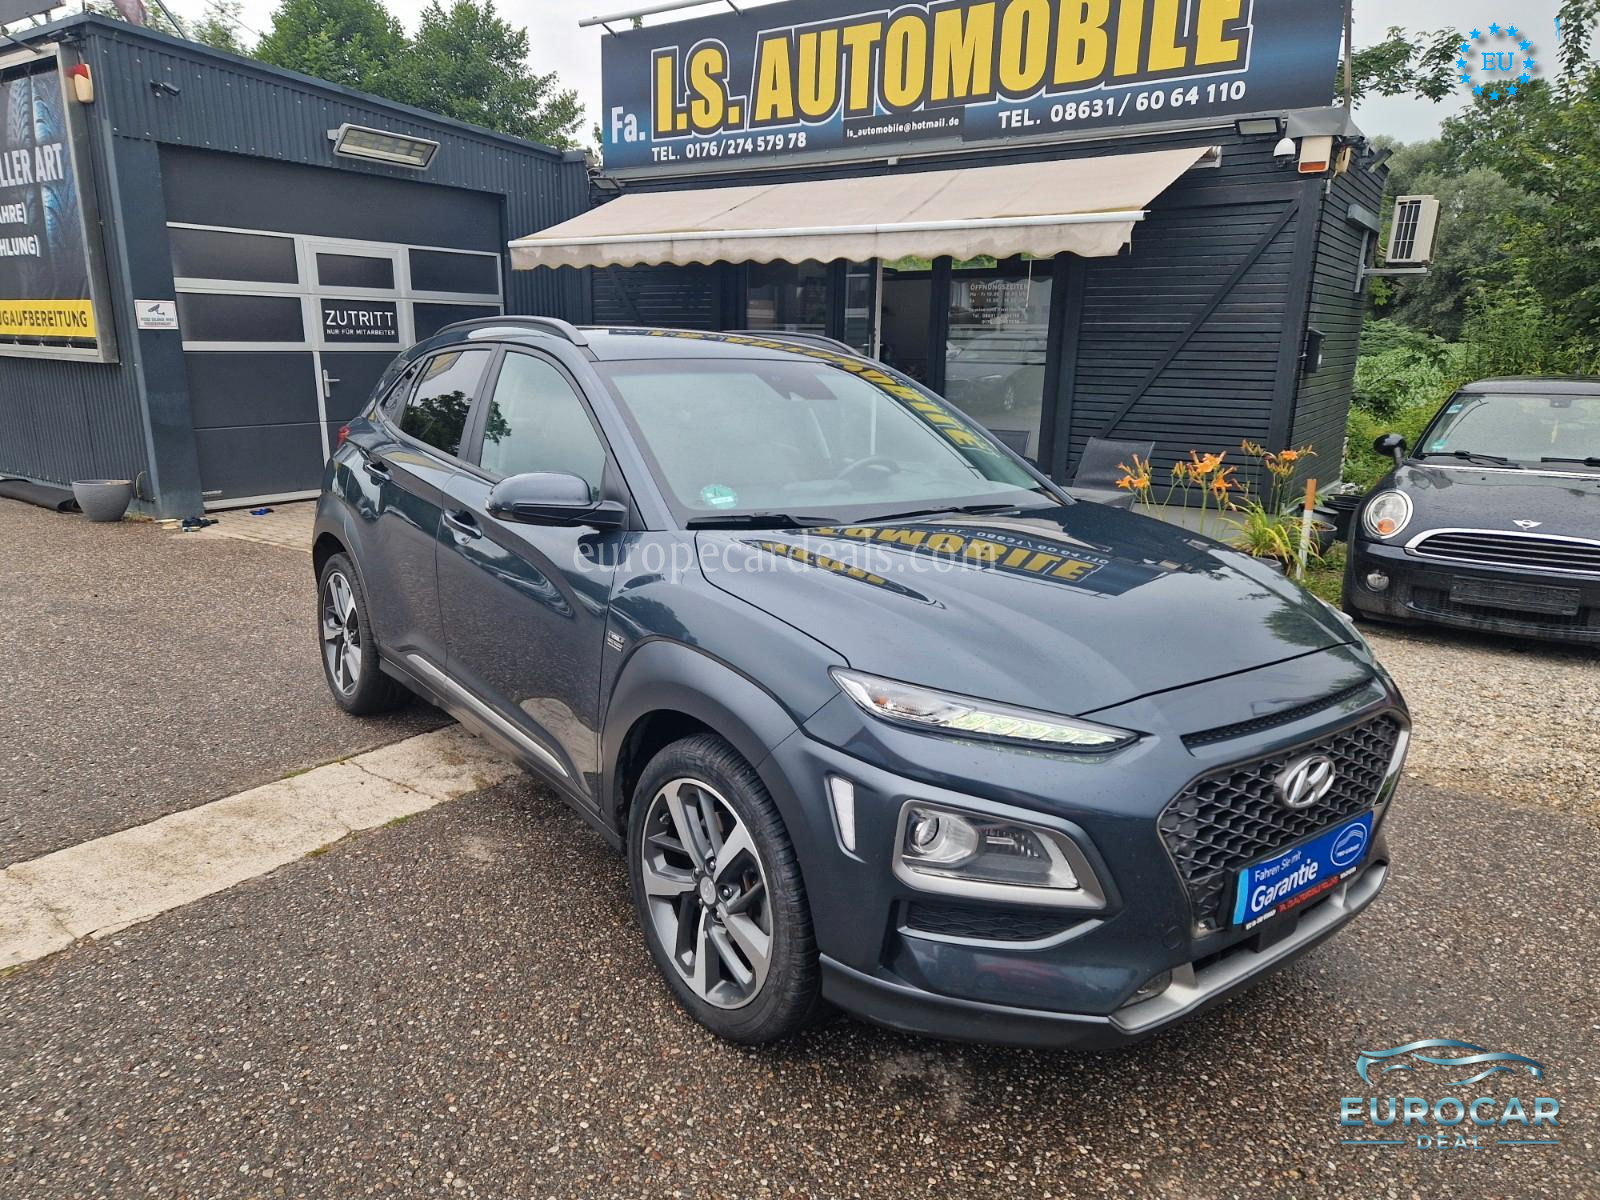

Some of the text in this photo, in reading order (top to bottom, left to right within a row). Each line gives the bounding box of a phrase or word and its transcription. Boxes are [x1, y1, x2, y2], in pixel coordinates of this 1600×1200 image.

[611, 0, 1247, 143] Fa. I.S. AUTOMOBILE
[998, 108, 1041, 128] TEL.
[1170, 86, 1199, 107] 64
[1206, 81, 1246, 103] 110
[35, 143, 64, 183] ART
[652, 146, 680, 161] TEL.
[757, 134, 784, 151] 579
[788, 132, 807, 149] 78
[325, 310, 394, 326] ZUTRITT
[341, 327, 354, 335] FÜR
[1251, 858, 1318, 912] Garantie
[1255, 864, 1281, 883] Fahren
